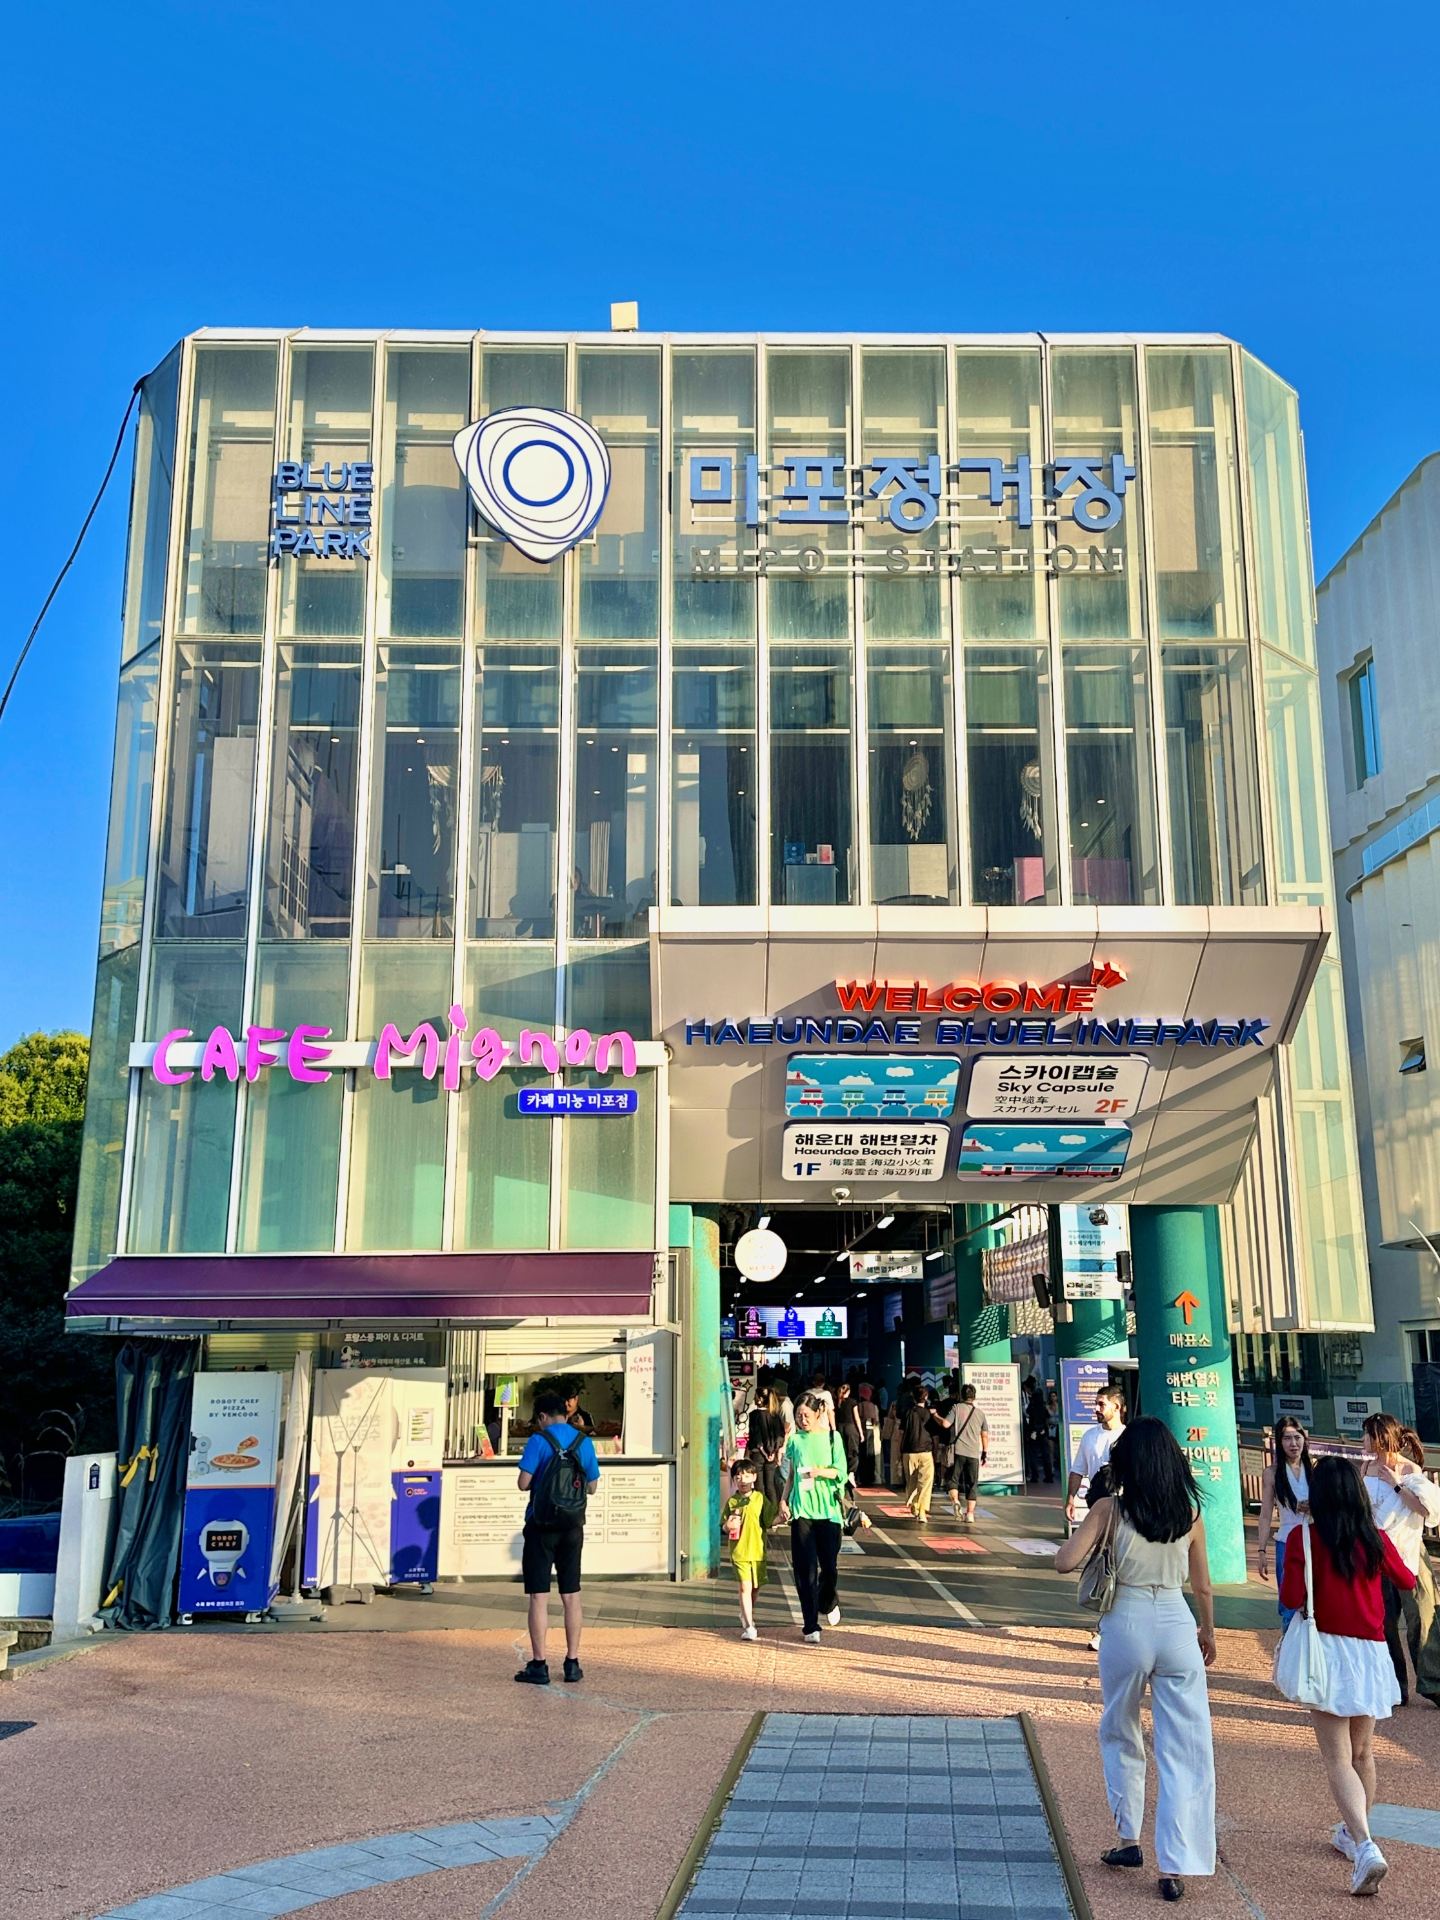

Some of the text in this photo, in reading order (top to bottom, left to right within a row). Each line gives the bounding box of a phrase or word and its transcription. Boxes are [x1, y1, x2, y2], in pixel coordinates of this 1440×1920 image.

[275, 462, 374, 493] BLUE
[690, 454, 1136, 533] 미포정거장
[274, 495, 373, 526] LINE
[273, 528, 372, 561] PARK
[691, 545, 1125, 575] MIPO STATION
[835, 978, 1099, 1014] WELCOME
[685, 1016, 921, 1047] HAEUNDAE
[153, 1004, 638, 1091] CAFE Mignon
[999, 1064, 1119, 1081] 스카이캡슐
[997, 1082, 1115, 1095] Sky Capsule
[527, 1092, 555, 1109] 카페
[588, 1093, 628, 1109] 미포점
[1094, 1098, 1129, 1113] 2F
[795, 1133, 938, 1146] 해운대 해변열차
[795, 1147, 936, 1156] Haeundae Beach Train
[793, 1162, 822, 1176] 1F
[375, 1333, 391, 1342] 파이
[393, 1333, 400, 1342] &
[1169, 1332, 1213, 1348] 매표소
[1166, 1371, 1220, 1388] 해변열차
[1172, 1390, 1219, 1407] 타는 곳
[1187, 1426, 1209, 1442] 2F
[1180, 1446, 1232, 1463] 카이캡슐
[1209, 1465, 1223, 1482] 곳
